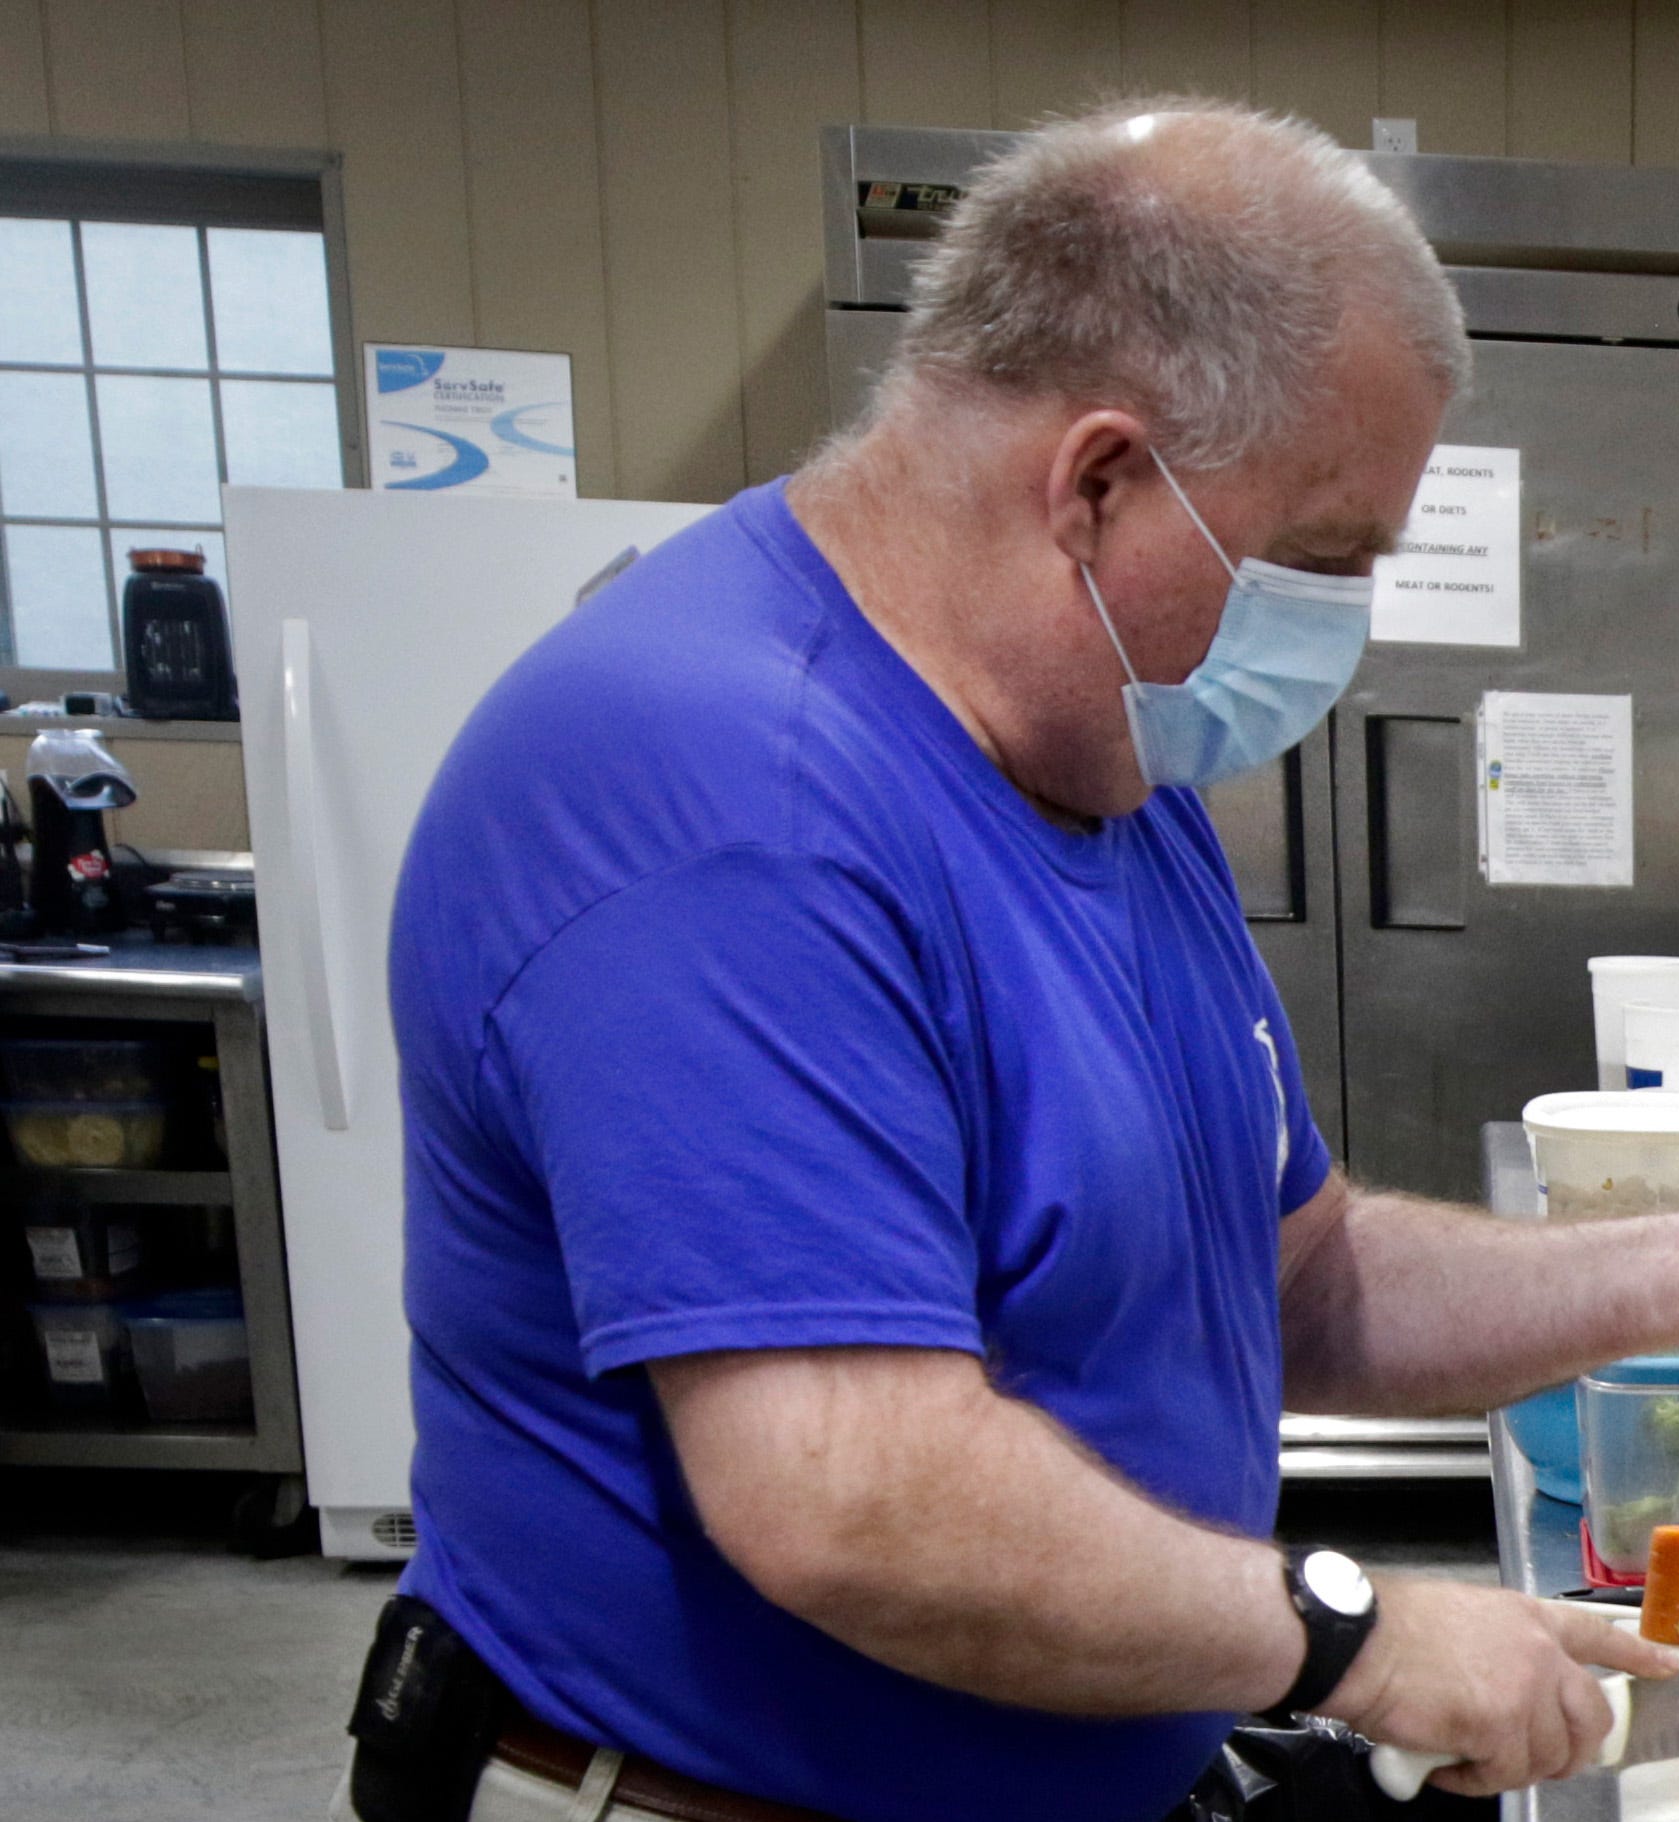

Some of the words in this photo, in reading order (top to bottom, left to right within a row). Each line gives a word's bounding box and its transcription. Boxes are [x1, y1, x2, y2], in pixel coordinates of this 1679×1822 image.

[433, 378, 505, 393] ServSafe
[1447, 467, 1494, 478] RODENTS
[1421, 504, 1436, 514] OR
[1439, 505, 1467, 515] DIETS
[1467, 546, 1489, 556] ANY
[1395, 580, 1425, 590] MEAT
[1427, 582, 1441, 590] OR
[1444, 582, 1494, 593] RODENTS!
